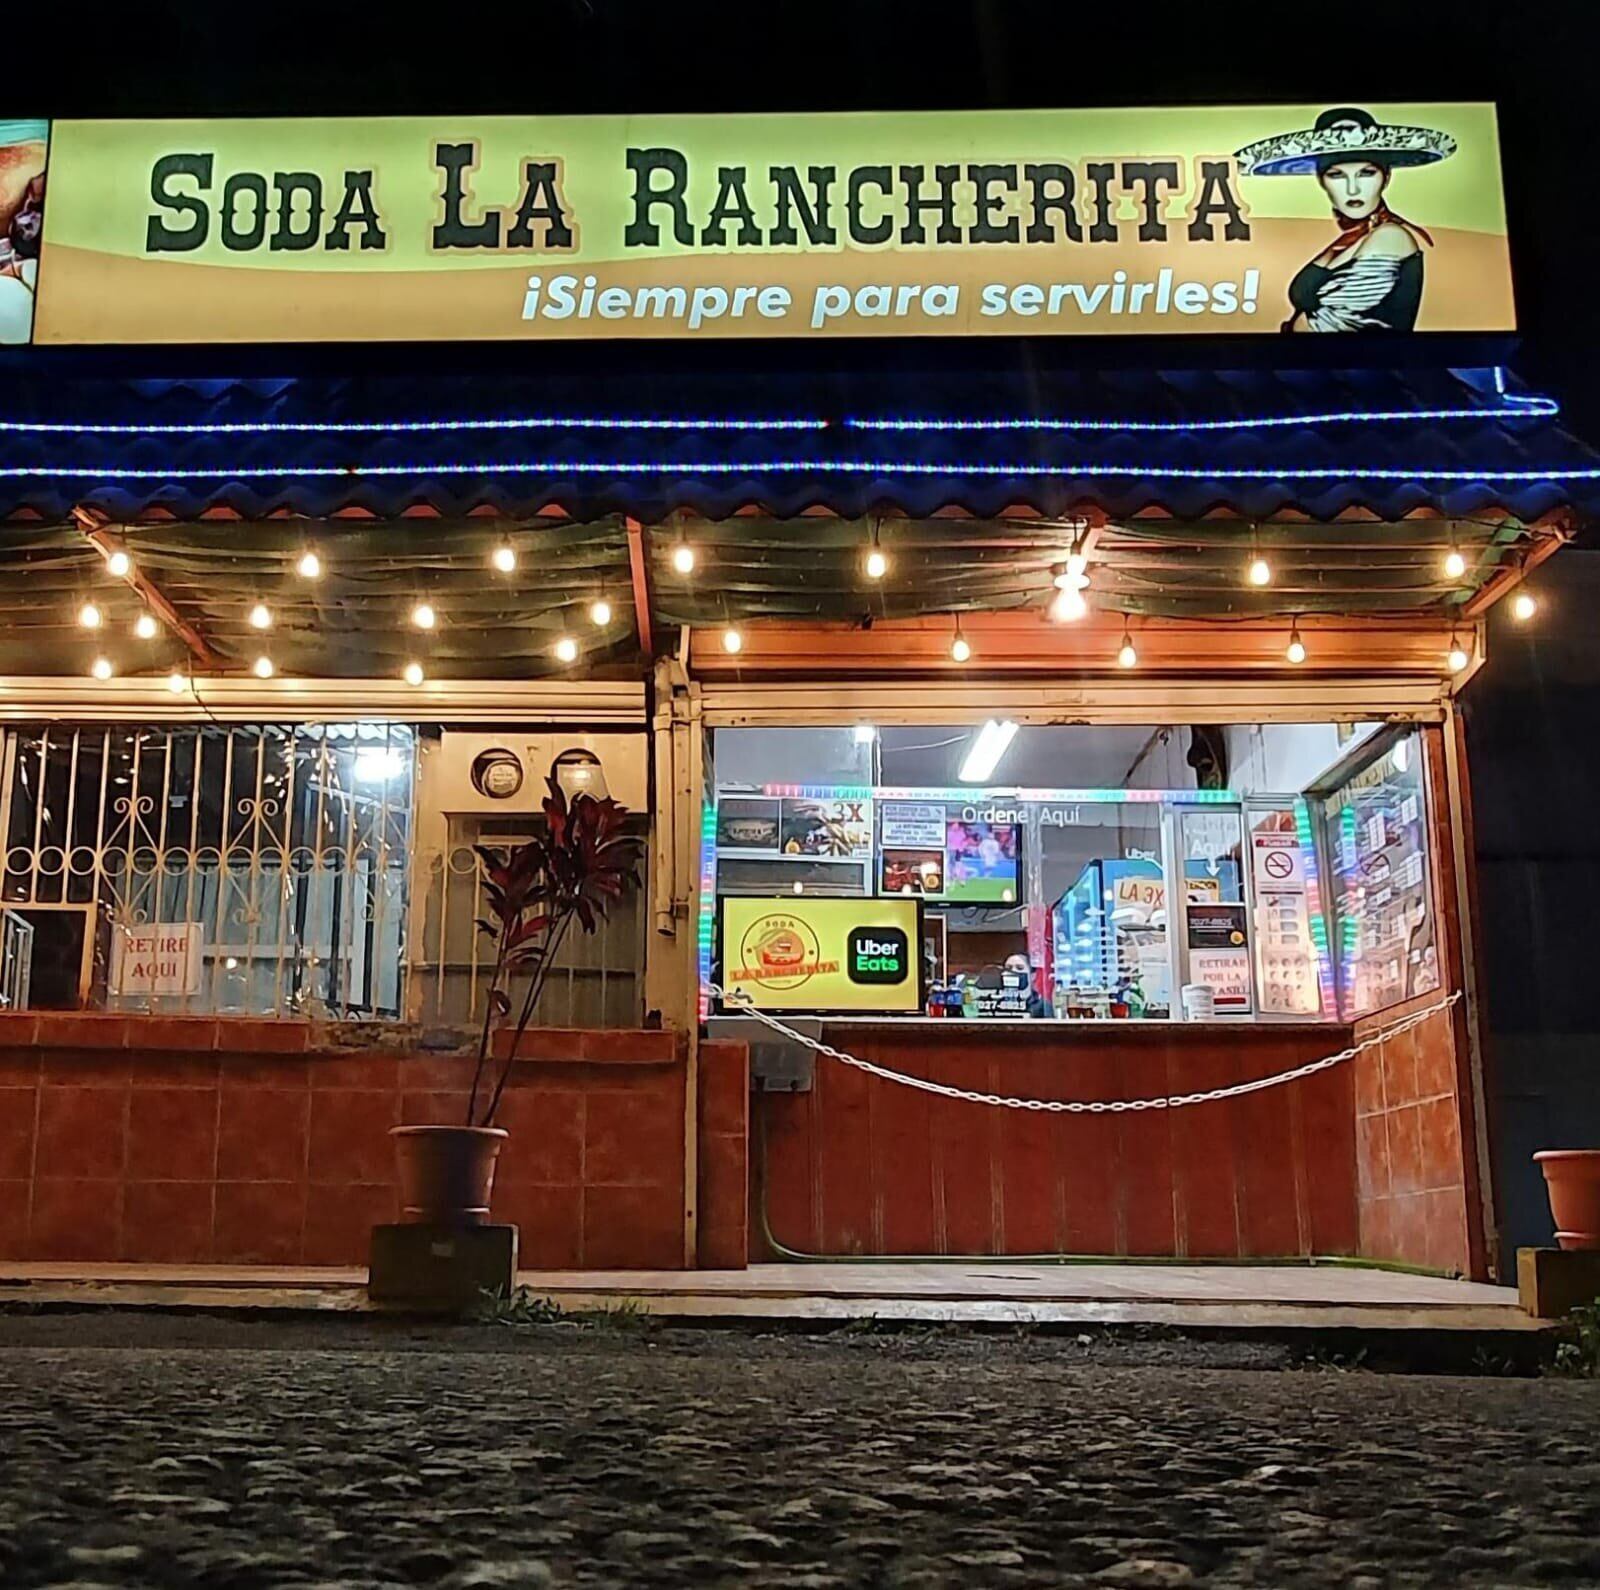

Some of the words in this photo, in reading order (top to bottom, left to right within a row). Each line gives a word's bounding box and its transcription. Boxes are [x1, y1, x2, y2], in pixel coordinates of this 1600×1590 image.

[810, 284, 960, 329] para
[979, 261, 1265, 317] servirles!
[962, 805, 1028, 824] Ordene
[1040, 805, 1079, 827] Aquí
[1119, 882, 1138, 901] LA
[765, 919, 796, 929] SODA
[126, 937, 188, 953] RETIRE
[856, 939, 899, 956] Uber
[131, 962, 177, 979] AQUI
[856, 956, 899, 971] Eats
